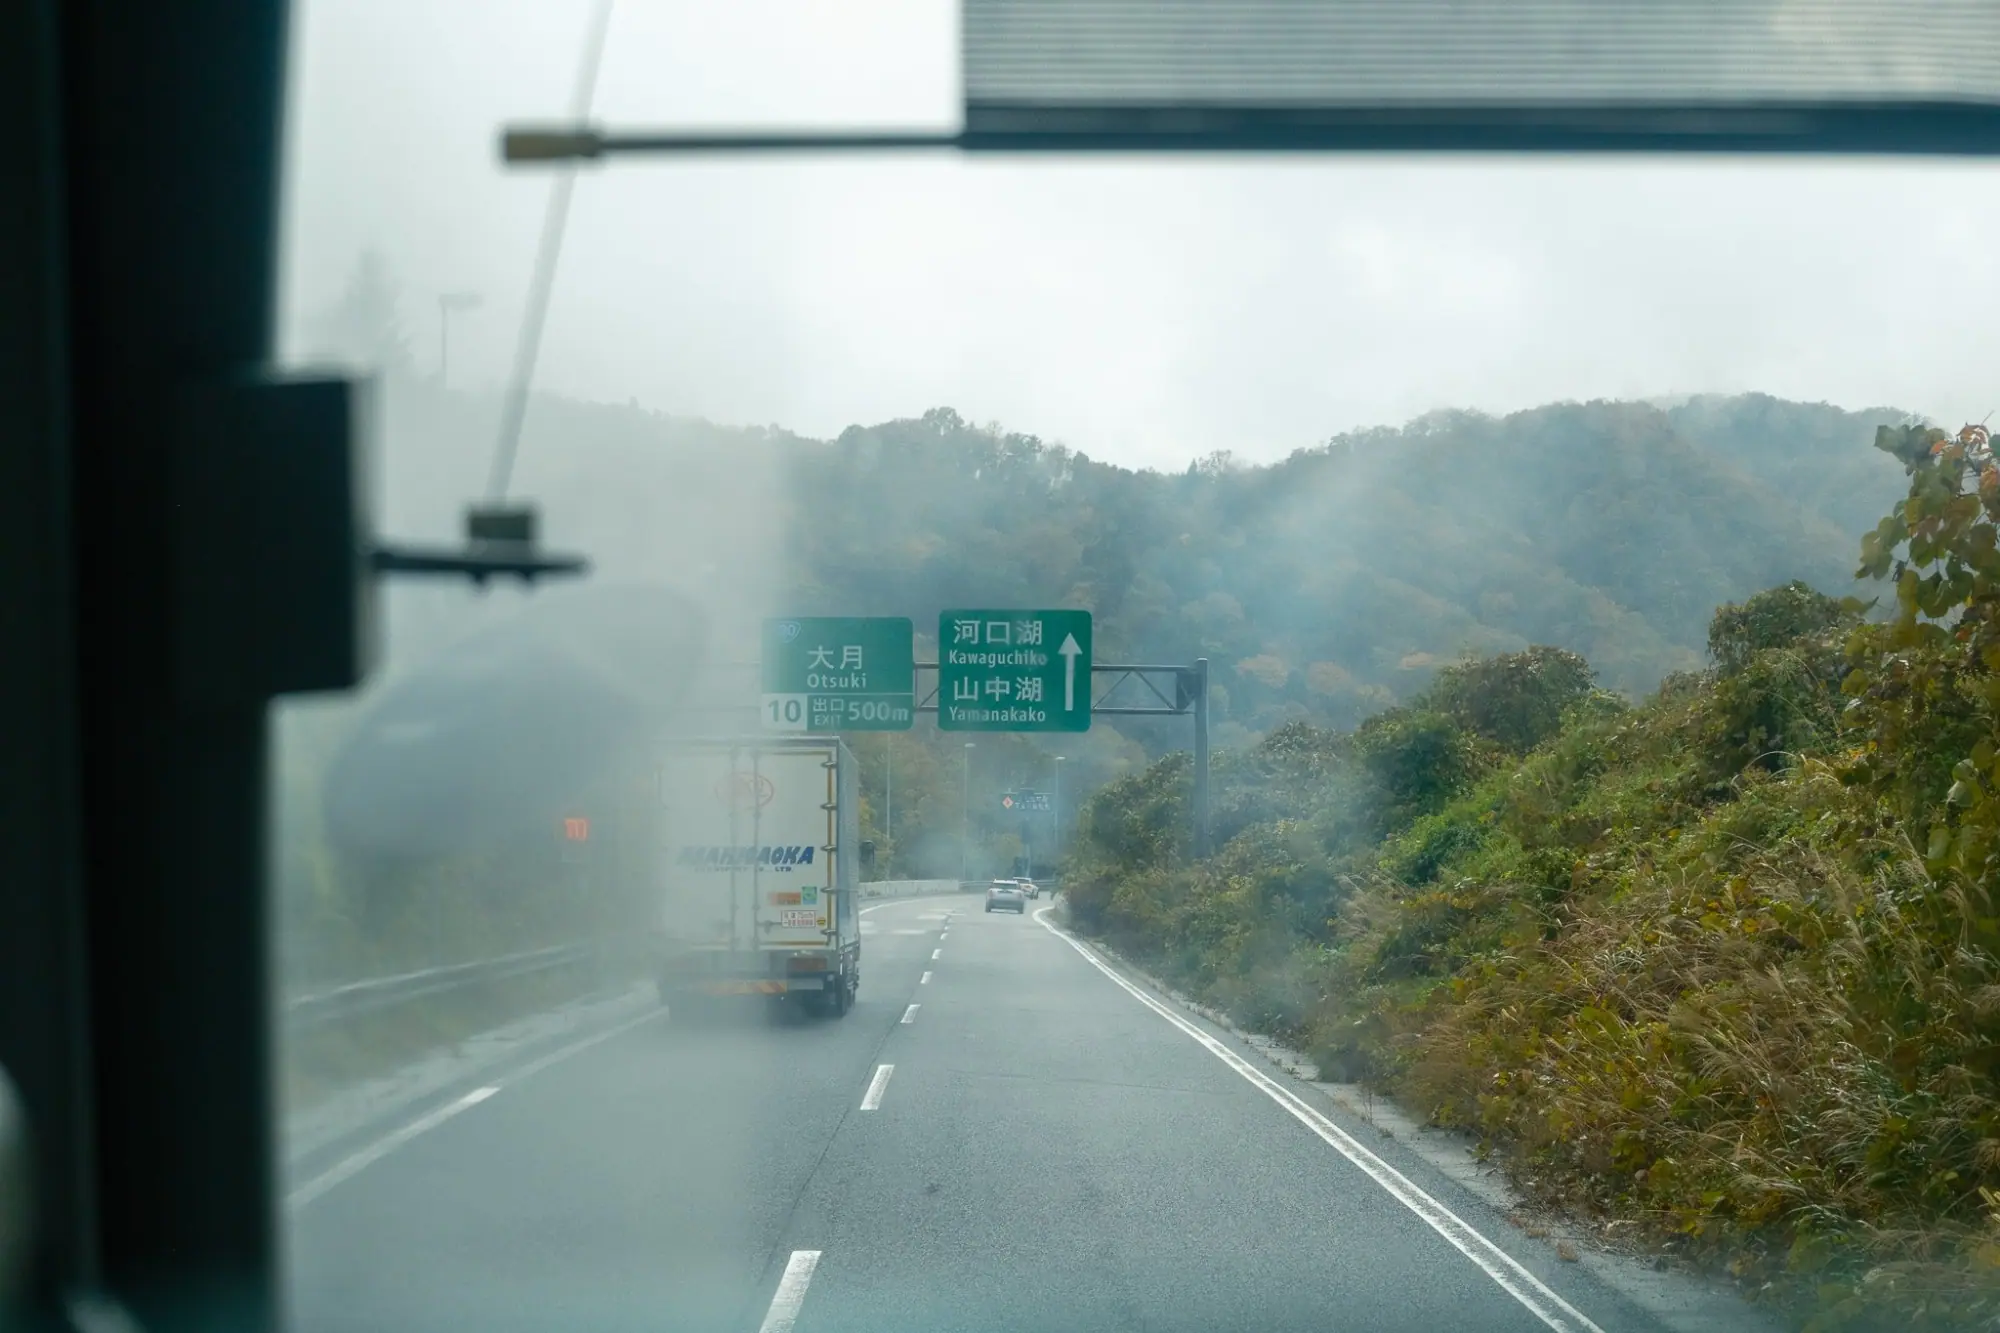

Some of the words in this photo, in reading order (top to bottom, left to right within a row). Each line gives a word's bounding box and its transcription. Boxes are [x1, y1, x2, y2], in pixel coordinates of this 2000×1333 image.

[953, 619, 1043, 646] 河口湖
[807, 645, 863, 670] 大月
[949, 649, 1048, 668] Kawaguchiko
[806, 672, 867, 689] Otsuki
[953, 675, 1043, 702] 山中湖
[767, 699, 802, 723] 10
[812, 697, 845, 712] 出口
[848, 701, 909, 722] 500m
[813, 714, 843, 727] EXIT
[949, 705, 1047, 723] Yamanakako
